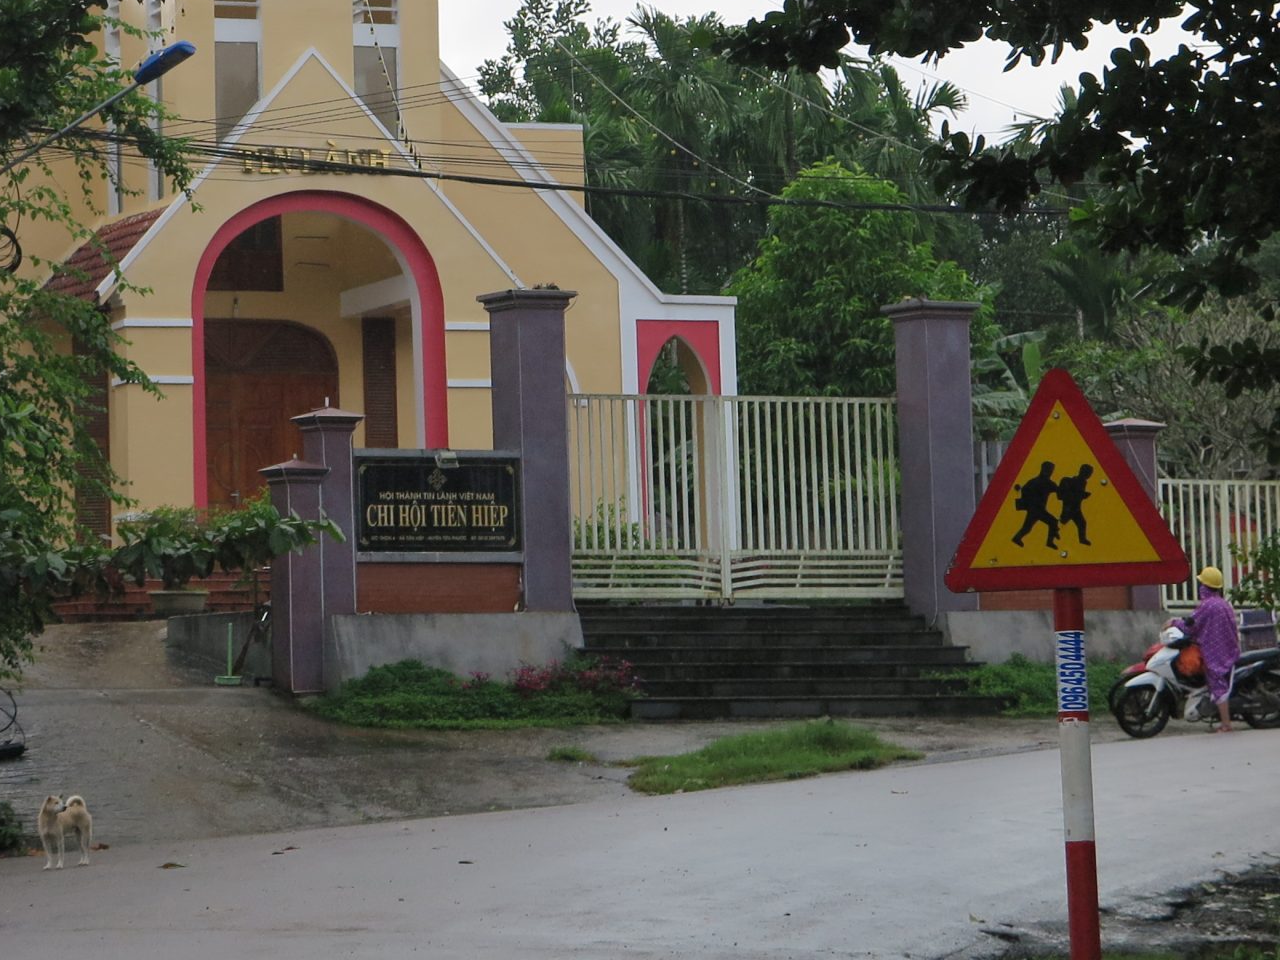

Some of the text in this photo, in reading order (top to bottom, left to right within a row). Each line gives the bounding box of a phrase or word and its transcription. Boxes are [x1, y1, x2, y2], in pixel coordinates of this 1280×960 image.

[367, 500, 509, 532] CHI HỘI TIÊN HIỆP
[1058, 632, 1087, 710] 0964504444
